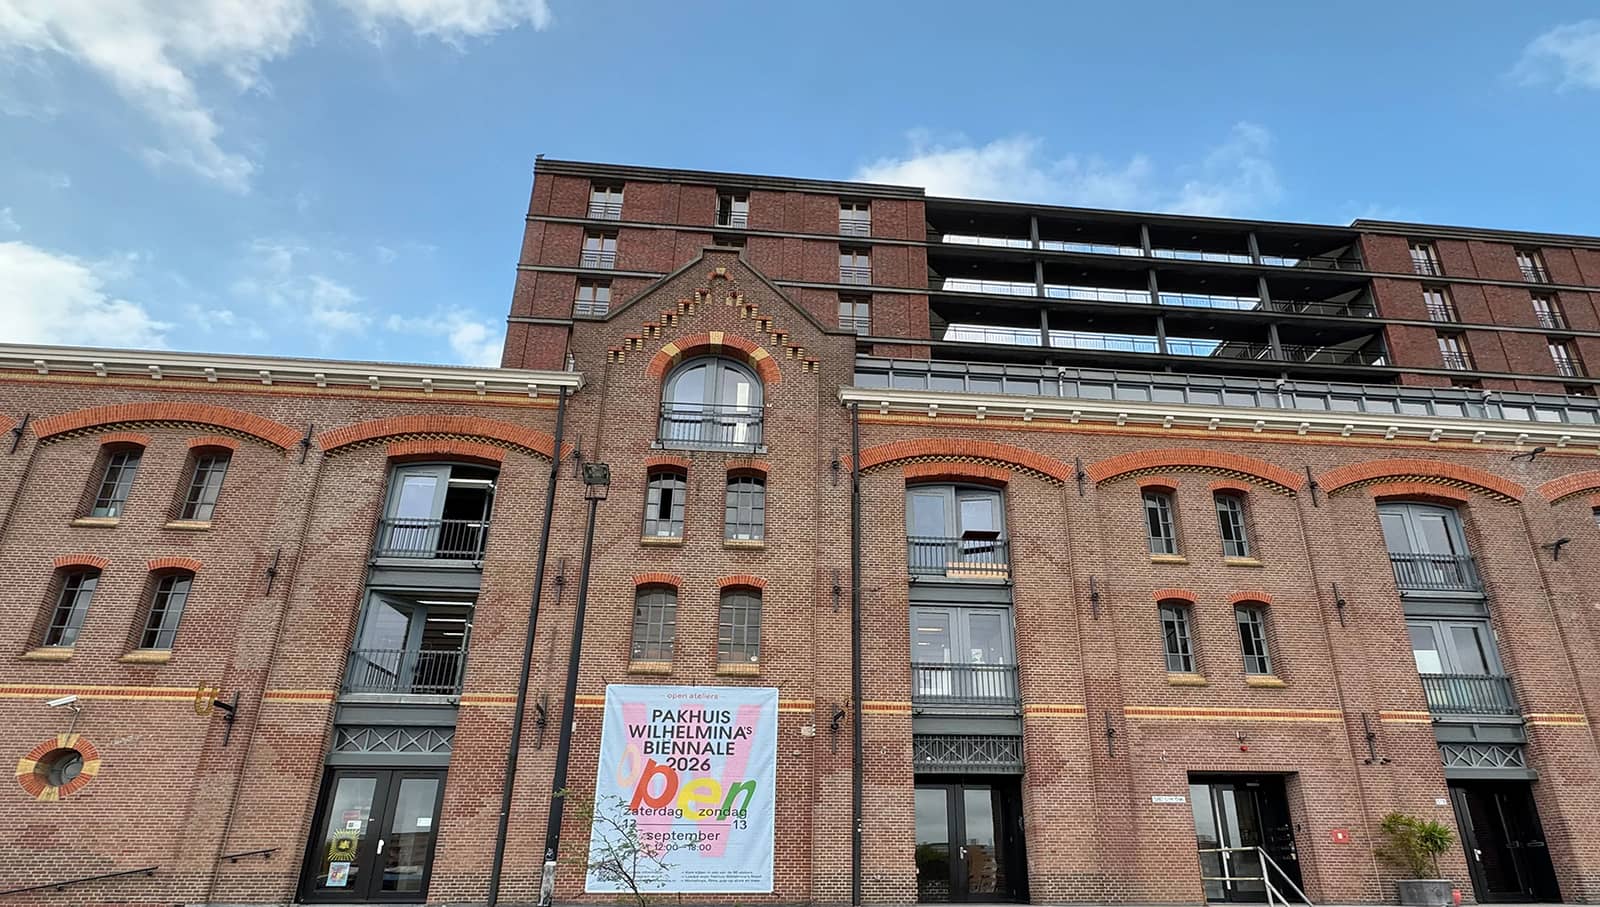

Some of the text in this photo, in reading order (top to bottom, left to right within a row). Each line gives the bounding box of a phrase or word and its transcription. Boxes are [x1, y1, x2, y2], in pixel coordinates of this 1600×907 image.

[667, 692, 719, 700] open ateliers
[652, 709, 731, 724] PAKHUIS
[666, 757, 711, 772] 2026
[617, 743, 757, 822] open
[624, 806, 748, 820] zaterdag zondag
[733, 820, 748, 830] 13
[646, 830, 721, 843] september
